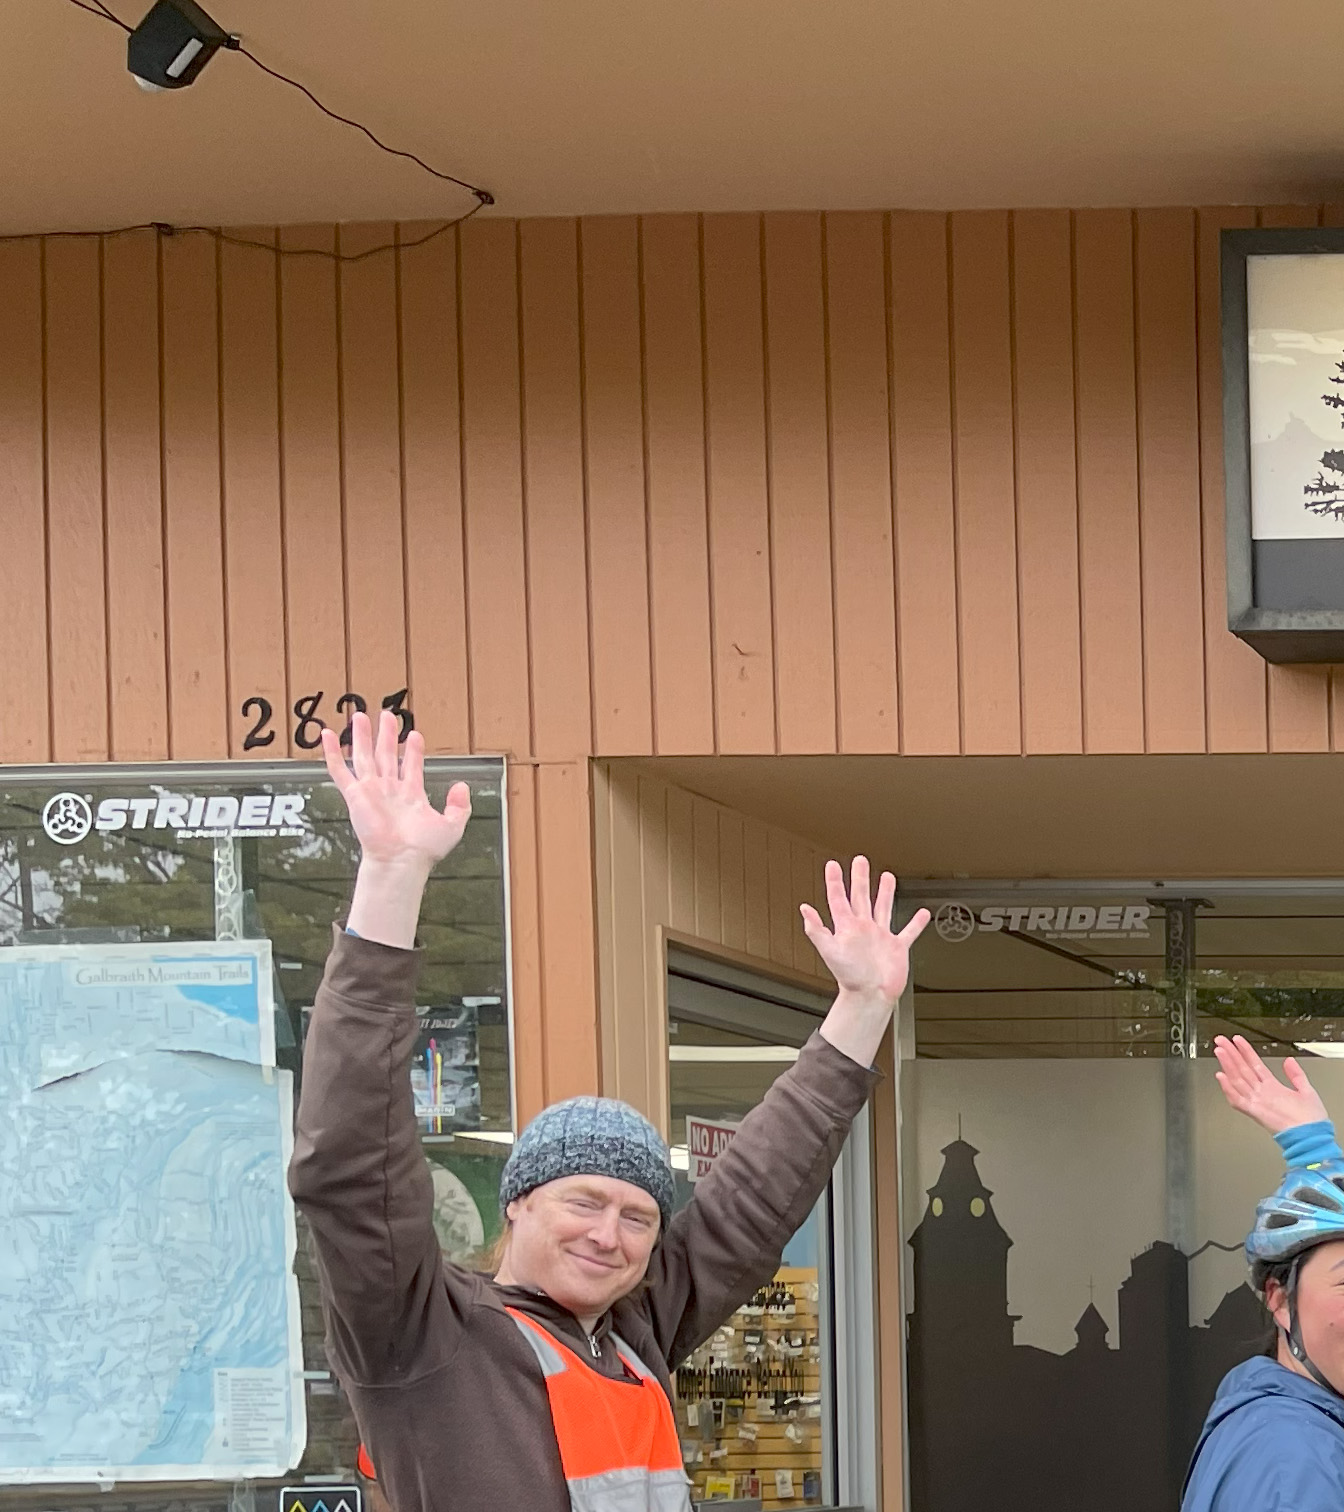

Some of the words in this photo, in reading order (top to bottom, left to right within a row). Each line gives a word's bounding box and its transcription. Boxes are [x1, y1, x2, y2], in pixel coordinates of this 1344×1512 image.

[95, 794, 306, 831] STRIDER
[978, 905, 1151, 932] STRIDER
[76, 967, 145, 985] Galbraith
[149, 966, 212, 983] Mountain
[213, 963, 249, 982] Trails
[692, 1125, 710, 1155] NO
